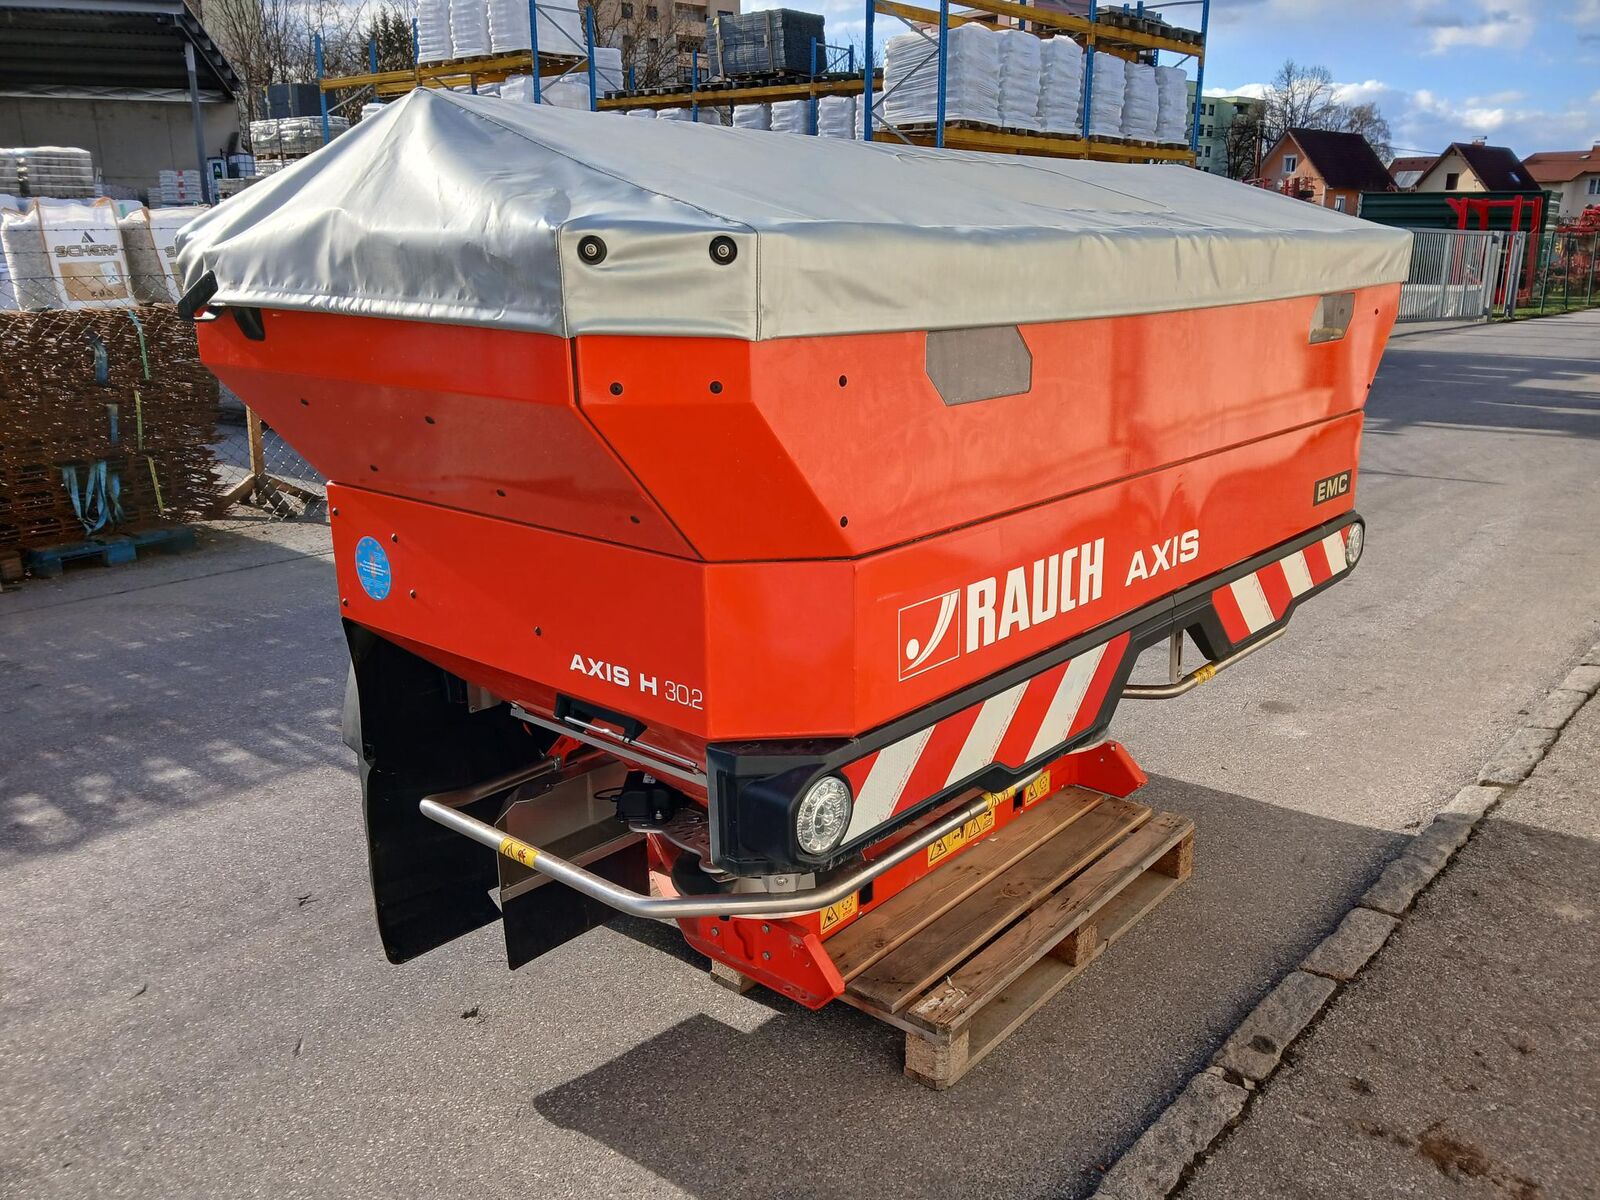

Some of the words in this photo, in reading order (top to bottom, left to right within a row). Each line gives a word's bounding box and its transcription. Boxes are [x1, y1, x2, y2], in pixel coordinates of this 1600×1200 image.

[1317, 473, 1348, 502] EMC
[965, 538, 1105, 653] RAUCH
[1125, 529, 1200, 586] AXIS
[569, 654, 630, 687] AXIS
[639, 673, 657, 696] H
[664, 681, 704, 710] 30.2
